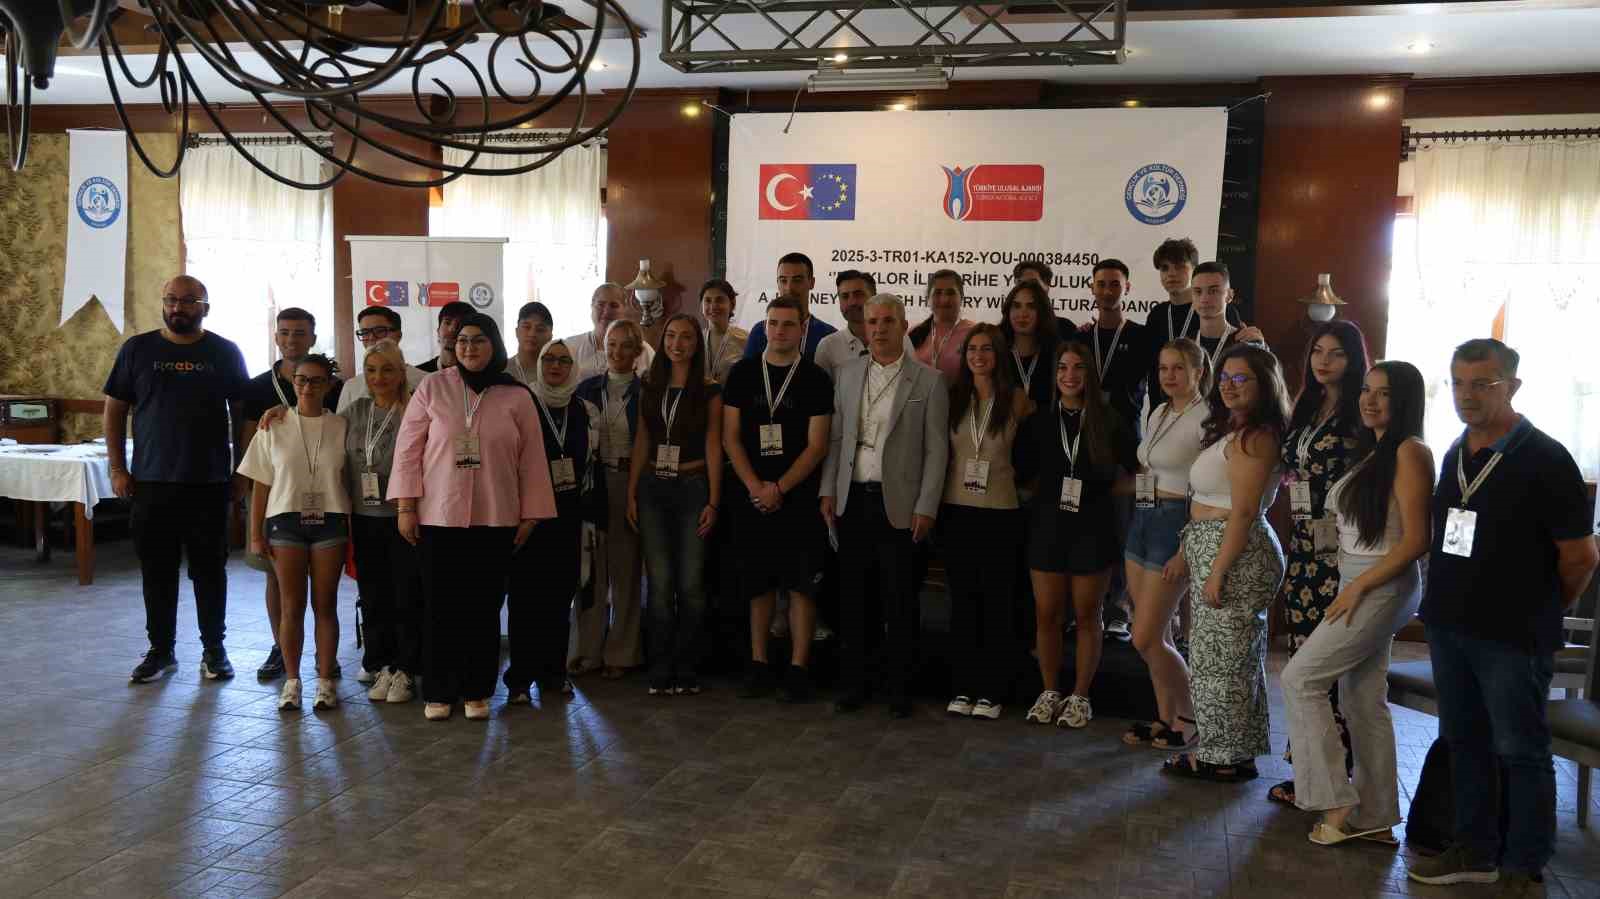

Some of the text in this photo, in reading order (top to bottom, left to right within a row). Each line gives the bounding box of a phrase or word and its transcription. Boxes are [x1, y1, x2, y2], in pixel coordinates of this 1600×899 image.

[831, 249, 1100, 267] 2025-3-TR01-KA152-YOU-000384450
[962, 271, 999, 287] RİHE
[758, 292, 769, 304] A
